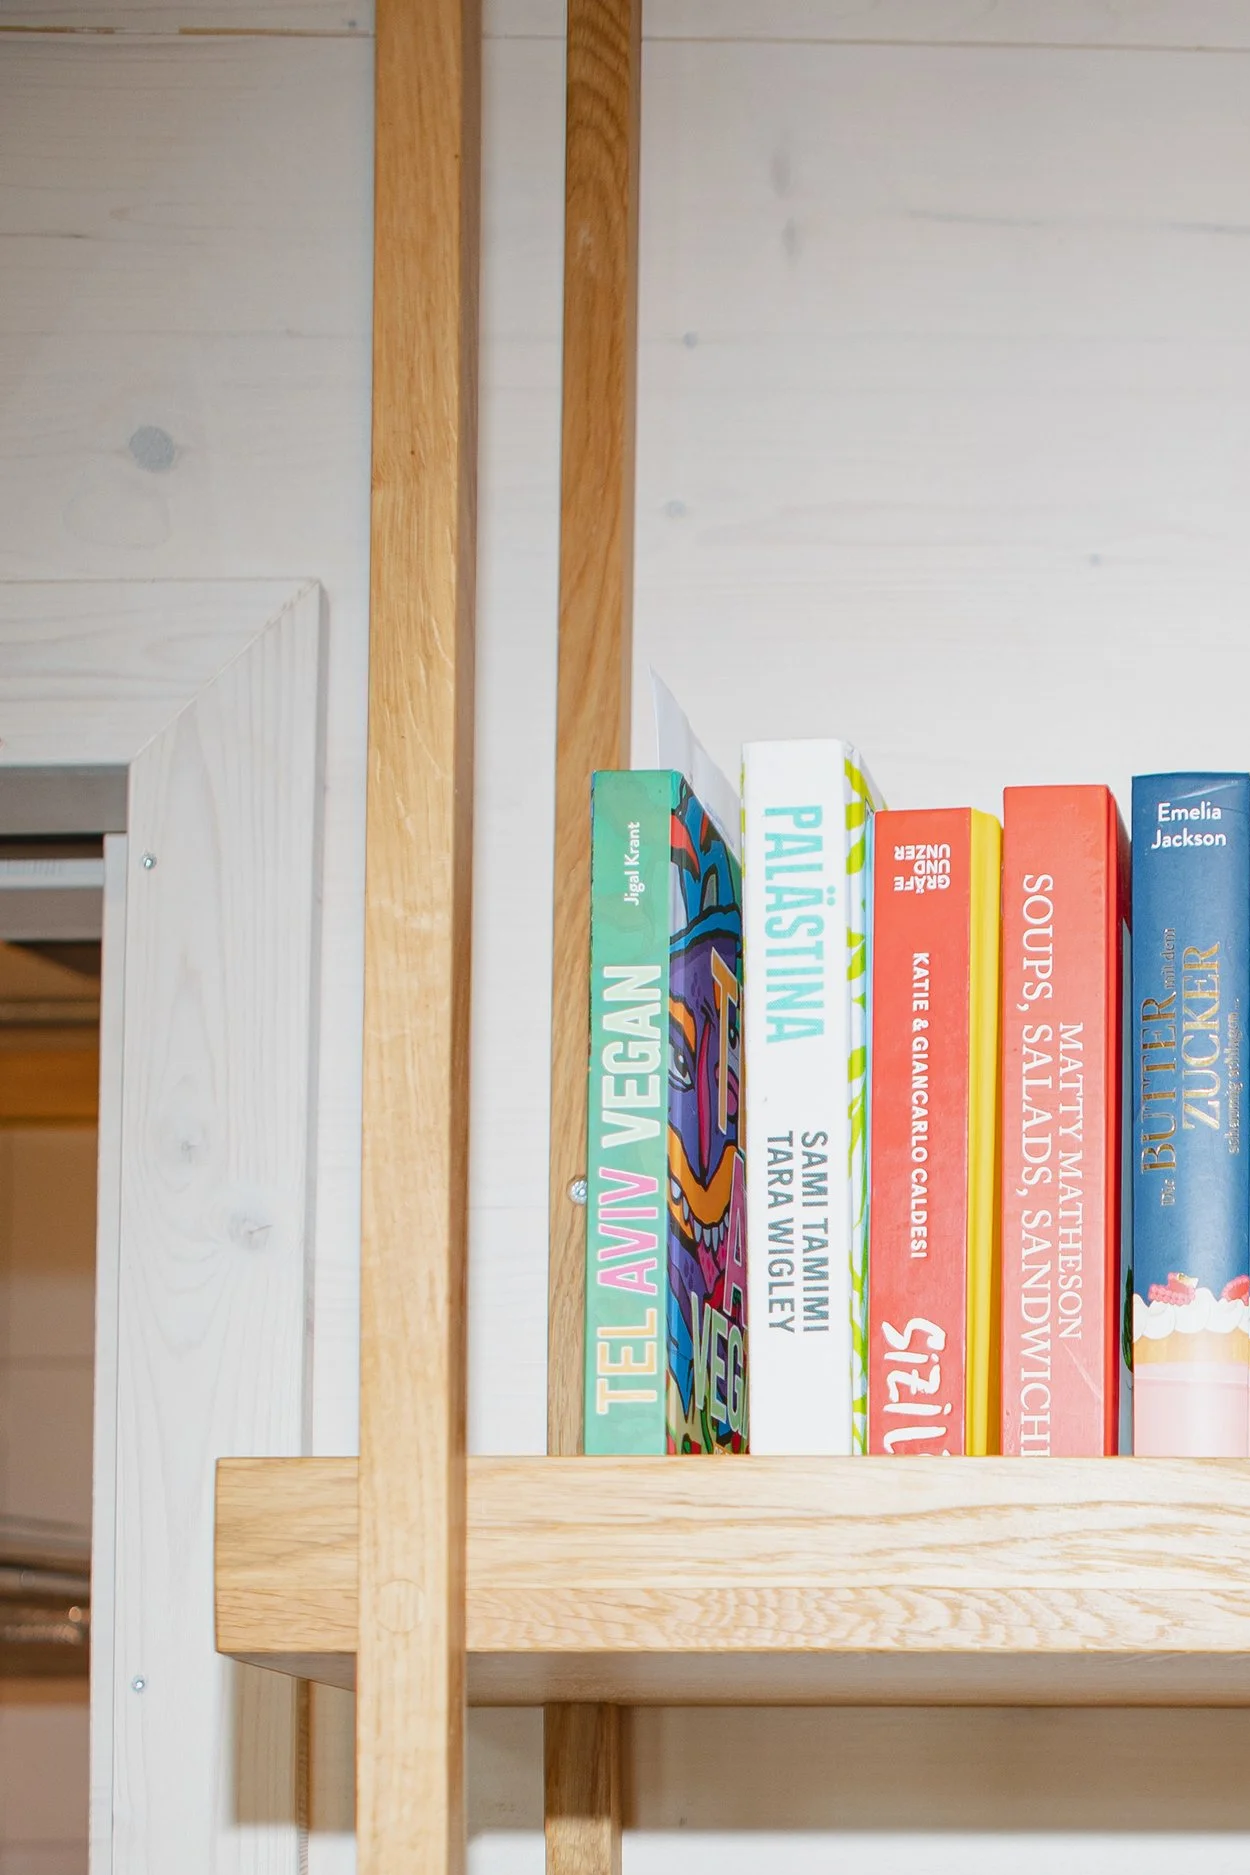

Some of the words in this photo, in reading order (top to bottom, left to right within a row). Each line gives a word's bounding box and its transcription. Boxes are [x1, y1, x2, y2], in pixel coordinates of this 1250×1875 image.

[624, 821, 641, 865] Krant
[893, 843, 951, 861] UNZER
[913, 859, 951, 875] UND
[1151, 828, 1227, 850] Jackson
[1157, 801, 1222, 823] Emelia
[623, 871, 645, 906] Jigal
[764, 804, 836, 1044] PALÄSTINA
[893, 875, 951, 894] GRÄFE
[1016, 873, 1054, 1012] SOUPS,
[911, 952, 930, 1013] KATIE
[911, 1017, 930, 1033] &
[1182, 941, 1221, 1131] ZUCKER
[601, 964, 662, 1149] VEGAN
[910, 1036, 930, 1163] GIANCARLO
[1015, 1023, 1053, 1197] SALADS,
[1058, 1021, 1084, 1142] MATTY
[1140, 991, 1177, 1175] BUTTER
[767, 1130, 794, 1209] TARA
[800, 1130, 829, 1207] SAMI
[910, 1170, 929, 1258] CALDESI
[597, 1166, 659, 1295] AVIV
[767, 1217, 796, 1334] WIGLEY
[801, 1217, 830, 1333] TAMIMI
[1057, 1150, 1084, 1340] MATHESON
[596, 1307, 658, 1415] TEL
[691, 1291, 749, 1439] VEG
[1020, 1208, 1053, 1456] SANDWICH
